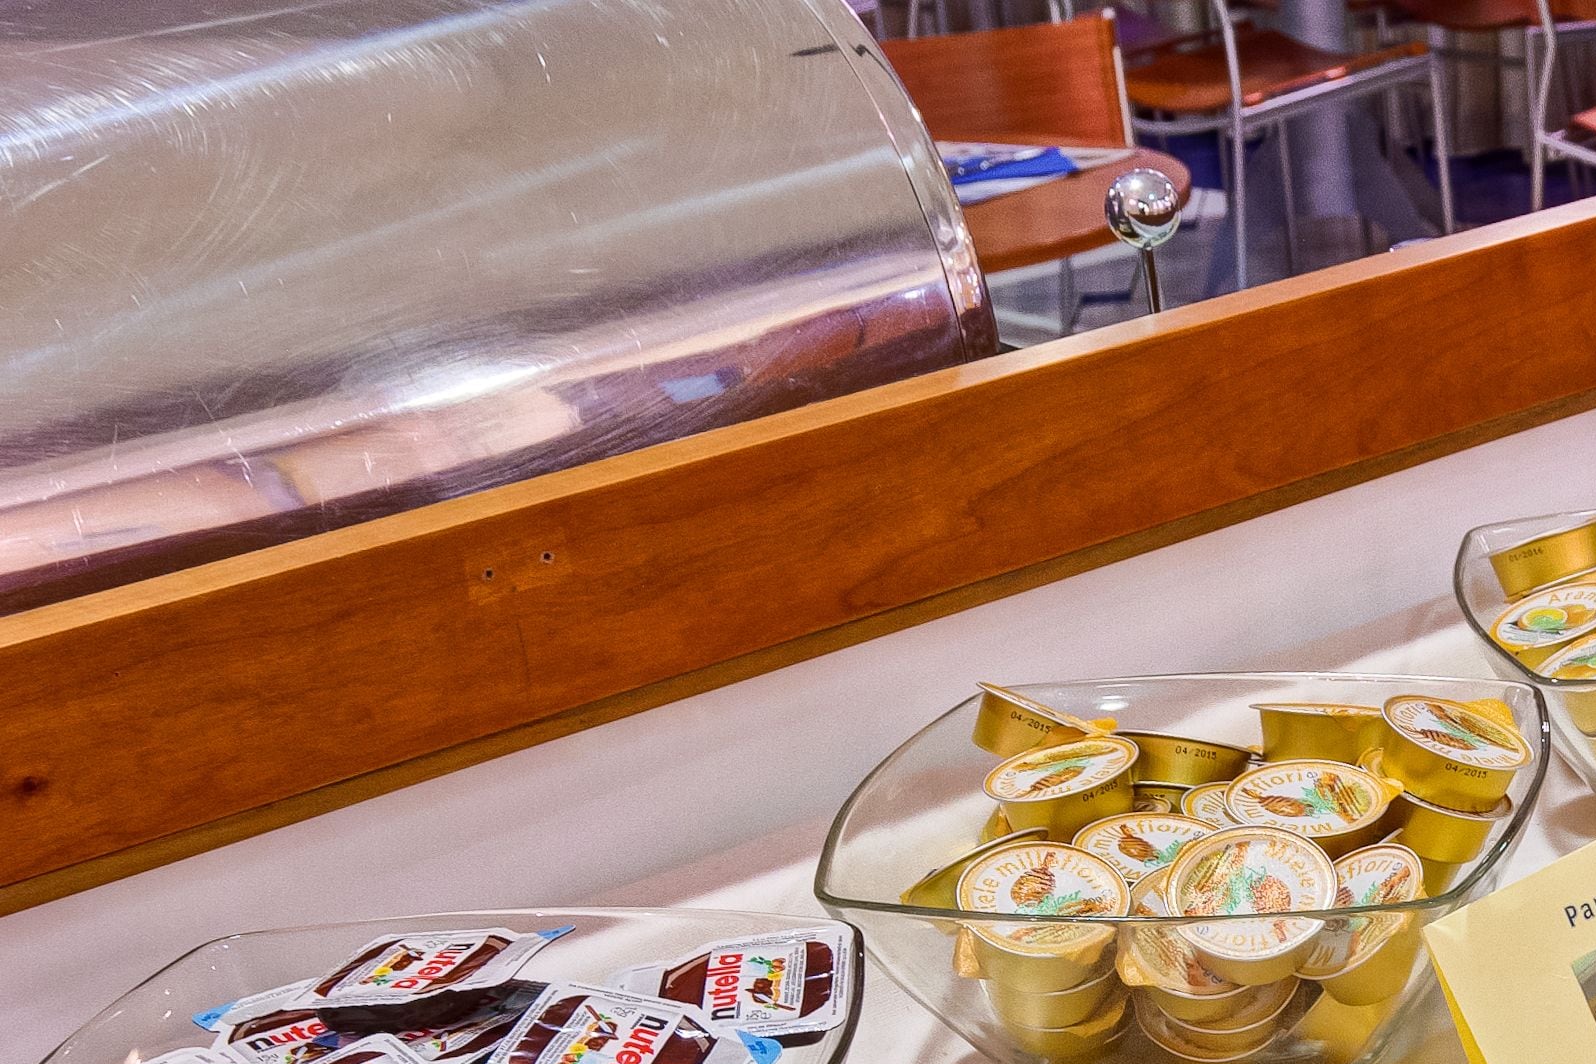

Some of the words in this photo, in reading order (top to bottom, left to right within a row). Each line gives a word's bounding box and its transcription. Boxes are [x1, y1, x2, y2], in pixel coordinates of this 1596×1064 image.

[1010, 710, 1052, 734] 04/2015
[1175, 745, 1218, 760] 04/2015
[1445, 762, 1488, 779] 04/2015
[1082, 780, 1119, 803] 04/2015
[972, 878, 1000, 912] iele
[390, 942, 475, 989] nutella
[706, 953, 744, 1021] nutella
[245, 1017, 329, 1051] nute
